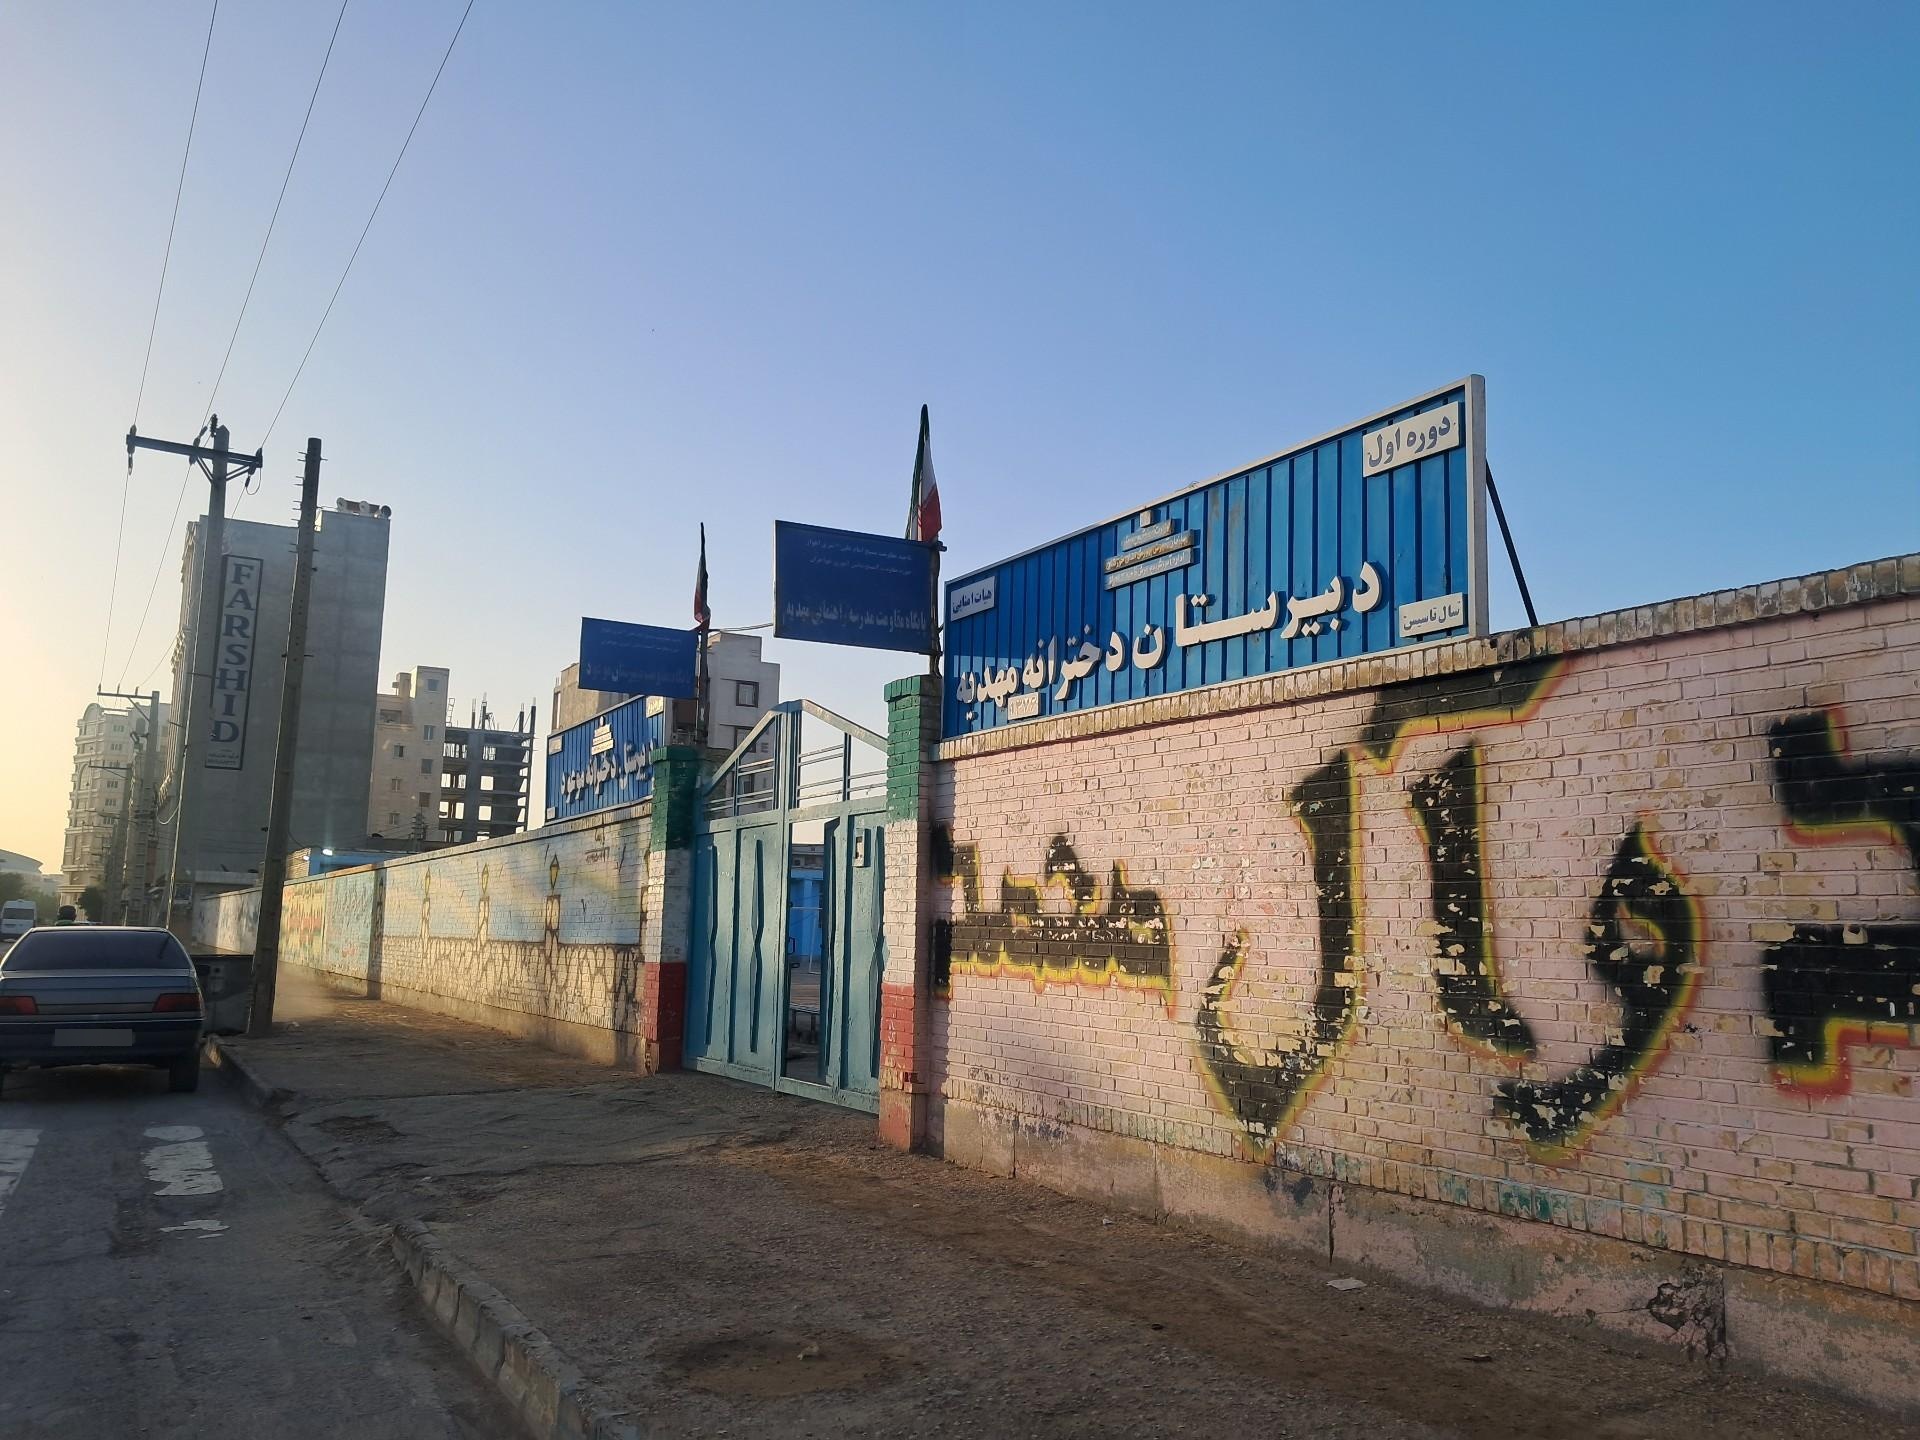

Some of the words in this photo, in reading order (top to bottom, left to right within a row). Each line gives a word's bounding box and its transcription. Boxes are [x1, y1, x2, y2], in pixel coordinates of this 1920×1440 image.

[1368, 426, 1401, 468] اول
[1406, 415, 1451, 454] دوره
[1132, 561, 1382, 669] دبیرستان
[1403, 607, 1437, 631] تاسیس
[1438, 604, 1460, 623] سال
[211, 562, 255, 743] FARSHID
[1022, 623, 1126, 700] دخترانه
[956, 665, 1018, 721] مهدیه
